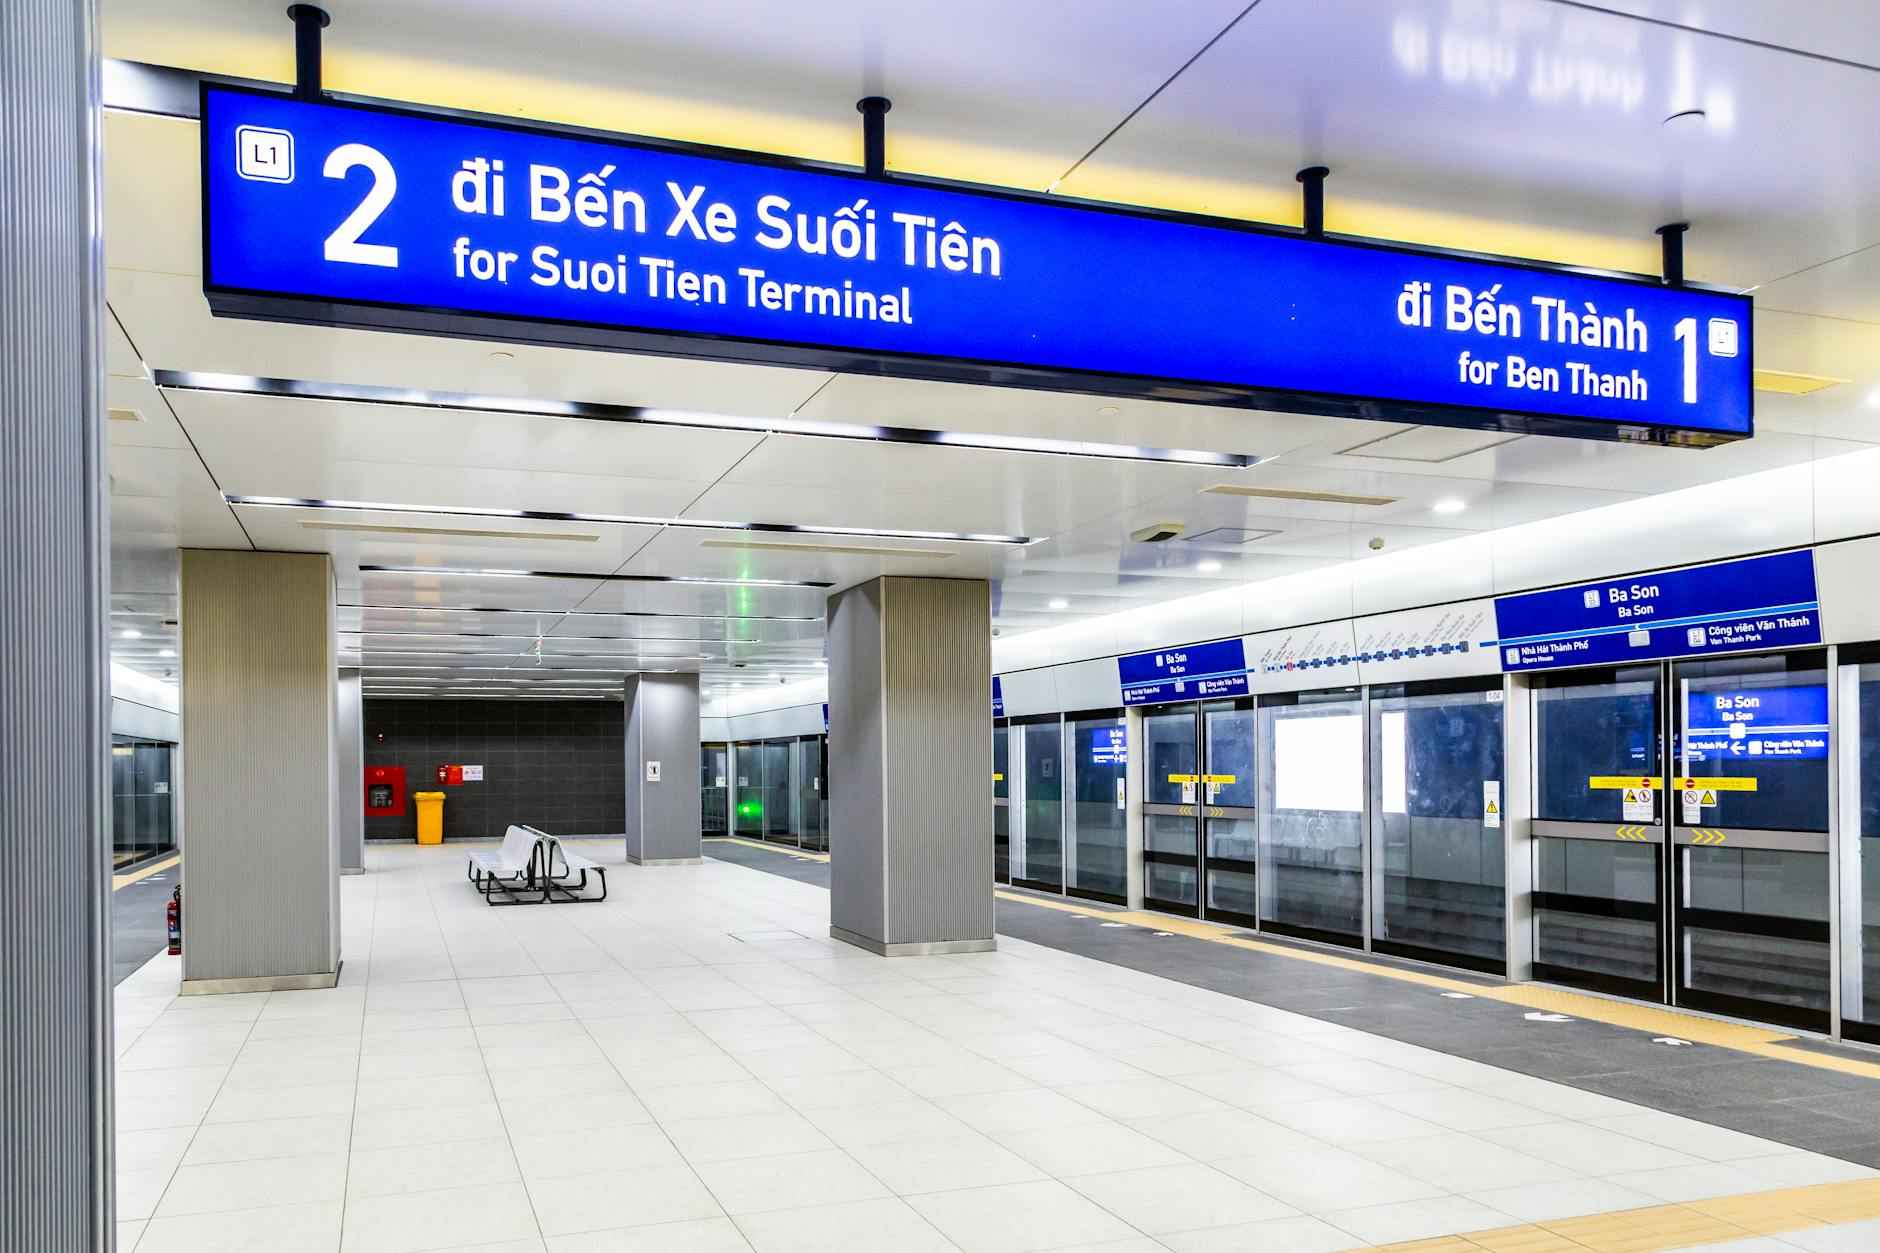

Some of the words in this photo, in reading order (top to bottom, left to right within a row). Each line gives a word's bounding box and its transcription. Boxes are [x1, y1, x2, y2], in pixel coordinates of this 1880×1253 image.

[254, 144, 276, 165] L1
[322, 143, 399, 268] 2
[451, 157, 505, 217] đi
[529, 164, 646, 233] Bến
[665, 181, 737, 243] Xe
[754, 194, 876, 261] Suối
[892, 212, 1001, 277] Tiên
[452, 236, 519, 282] for
[530, 245, 627, 294] Suoi
[639, 256, 726, 305] Tien
[738, 267, 913, 325] Terminal
[1397, 280, 1432, 328] đi
[1446, 284, 1521, 338] Bến
[1531, 295, 1648, 353] Thành
[1458, 350, 1500, 386] for
[1506, 355, 1560, 393] Ben
[1565, 361, 1648, 401] Thanh
[1674, 317, 1698, 404] 1
[1608, 587, 1628, 604] Ba
[1630, 584, 1660, 600] Son
[1617, 606, 1632, 618] Ba
[1633, 604, 1654, 616] Son
[1166, 654, 1175, 664] Ba
[1175, 653, 1187, 663] Son
[1716, 696, 1733, 709] Ba
[1734, 695, 1761, 708] Son
[1722, 712, 1735, 721] Ba
[1735, 711, 1754, 721] Son
